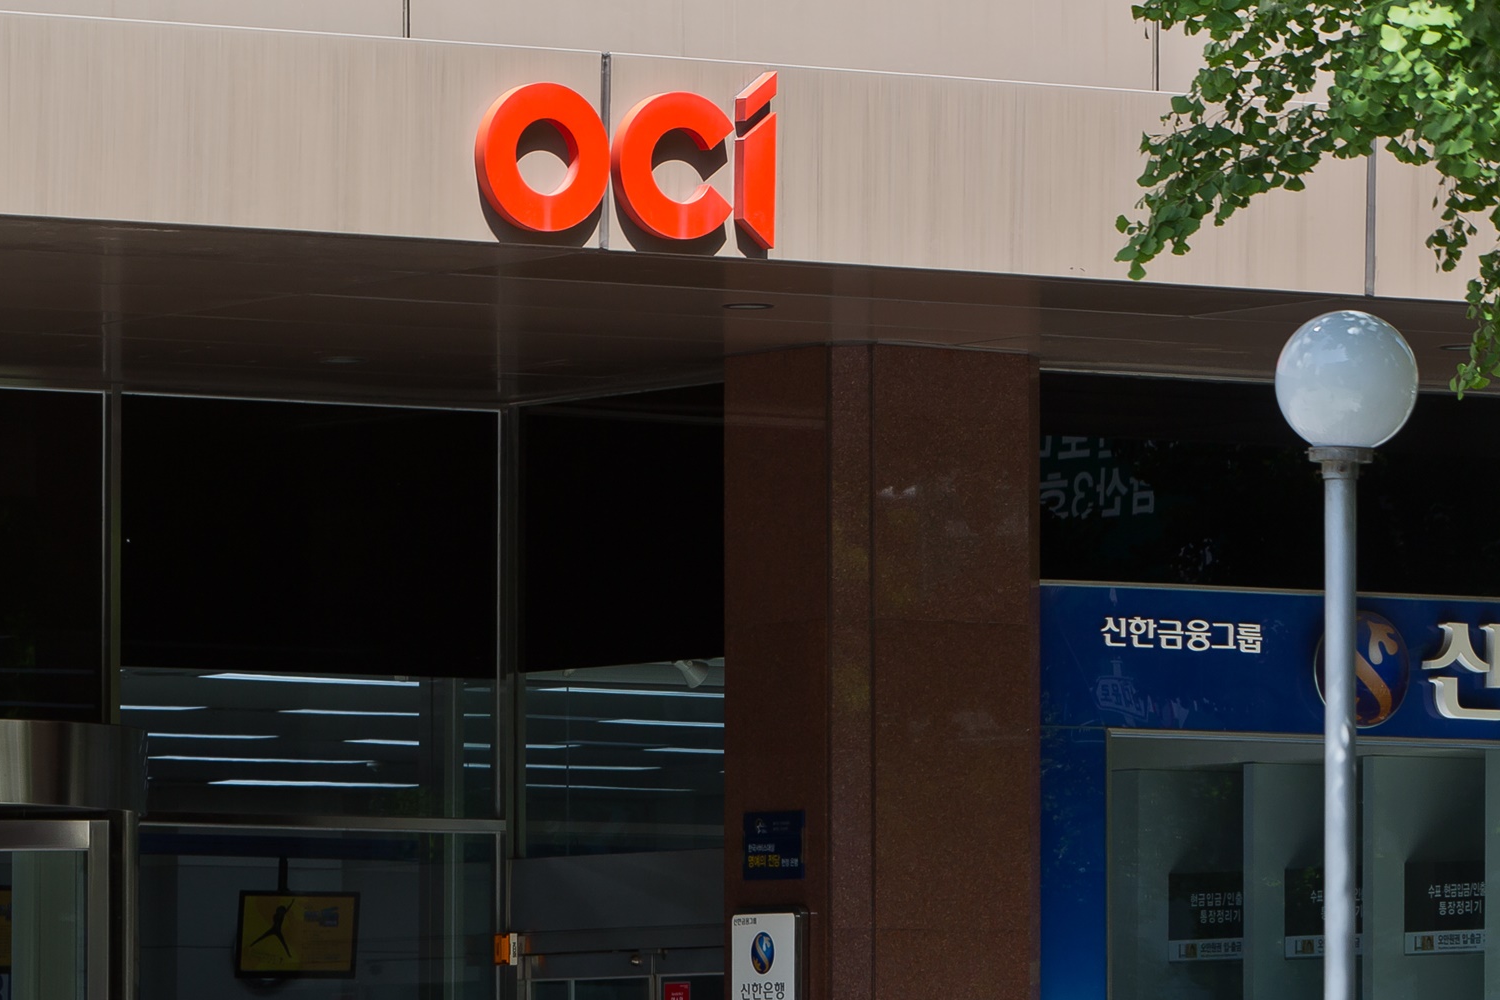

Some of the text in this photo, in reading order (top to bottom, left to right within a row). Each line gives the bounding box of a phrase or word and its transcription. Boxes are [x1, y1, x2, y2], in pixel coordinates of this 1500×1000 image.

[1100, 615, 1264, 655] 신한금융그룹
[1200, 909, 1242, 924] 통장정리기
[1438, 900, 1482, 916] 통장정리기
[740, 981, 785, 1000] 신한은행
